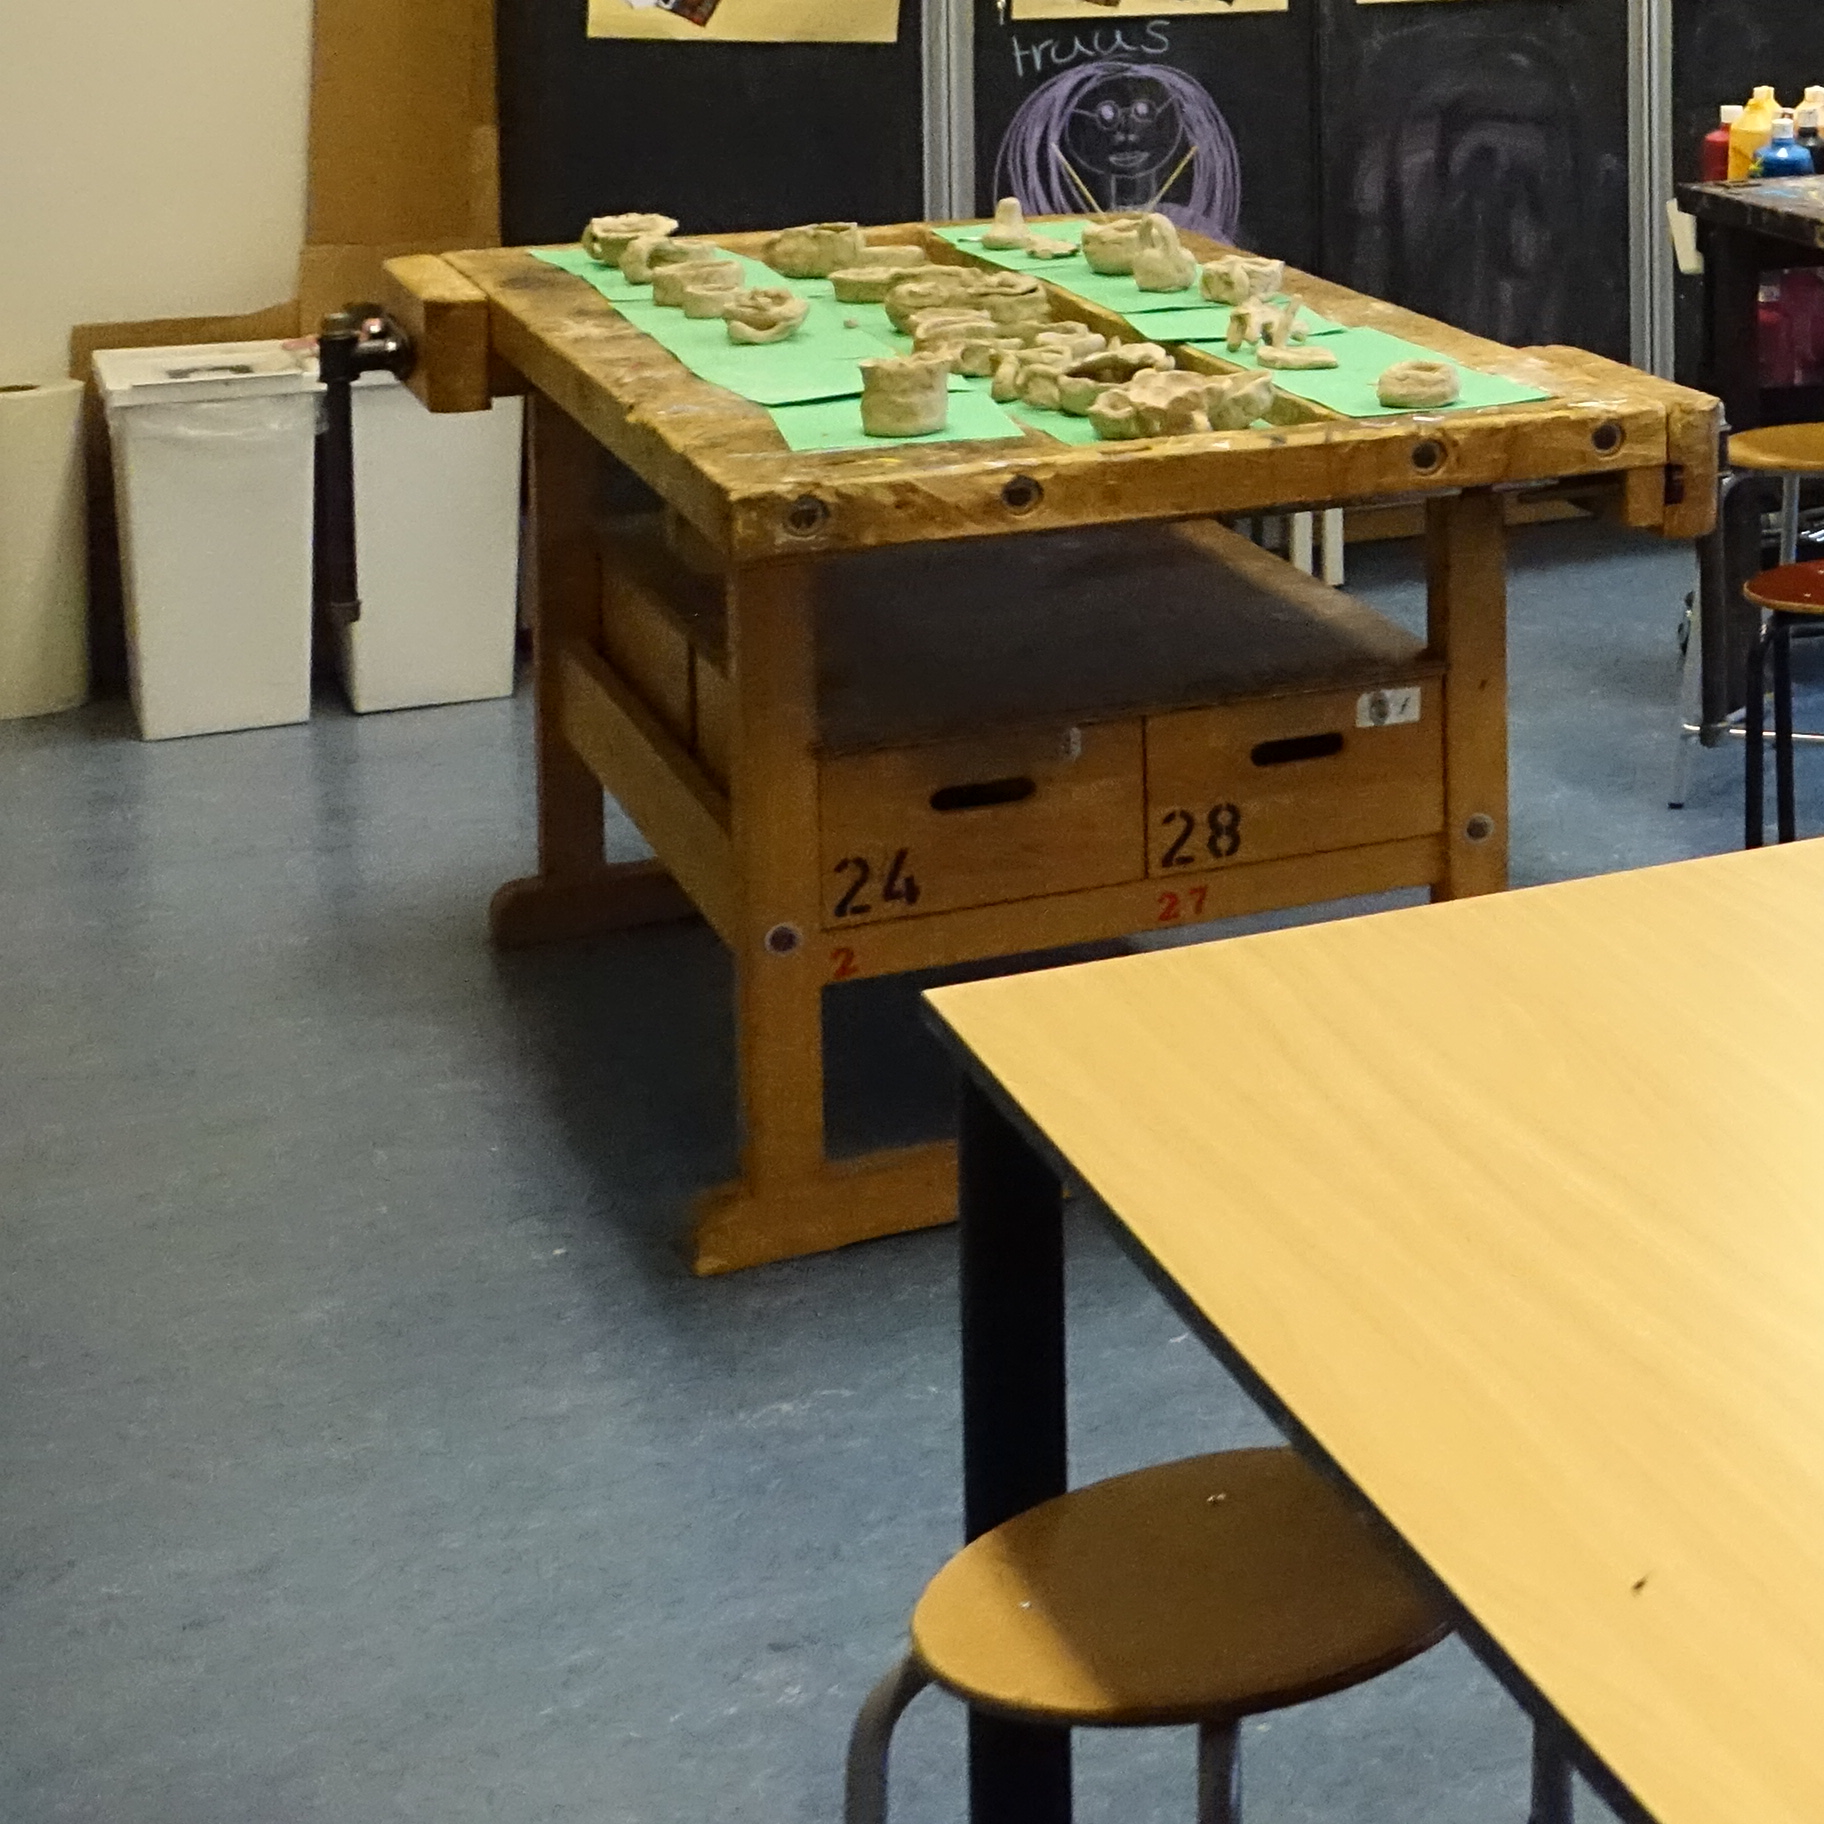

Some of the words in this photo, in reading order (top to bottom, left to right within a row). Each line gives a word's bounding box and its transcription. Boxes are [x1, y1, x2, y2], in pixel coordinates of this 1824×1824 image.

[1160, 802, 1243, 869] 28
[833, 846, 921, 919] 24
[1156, 885, 1209, 922] 27
